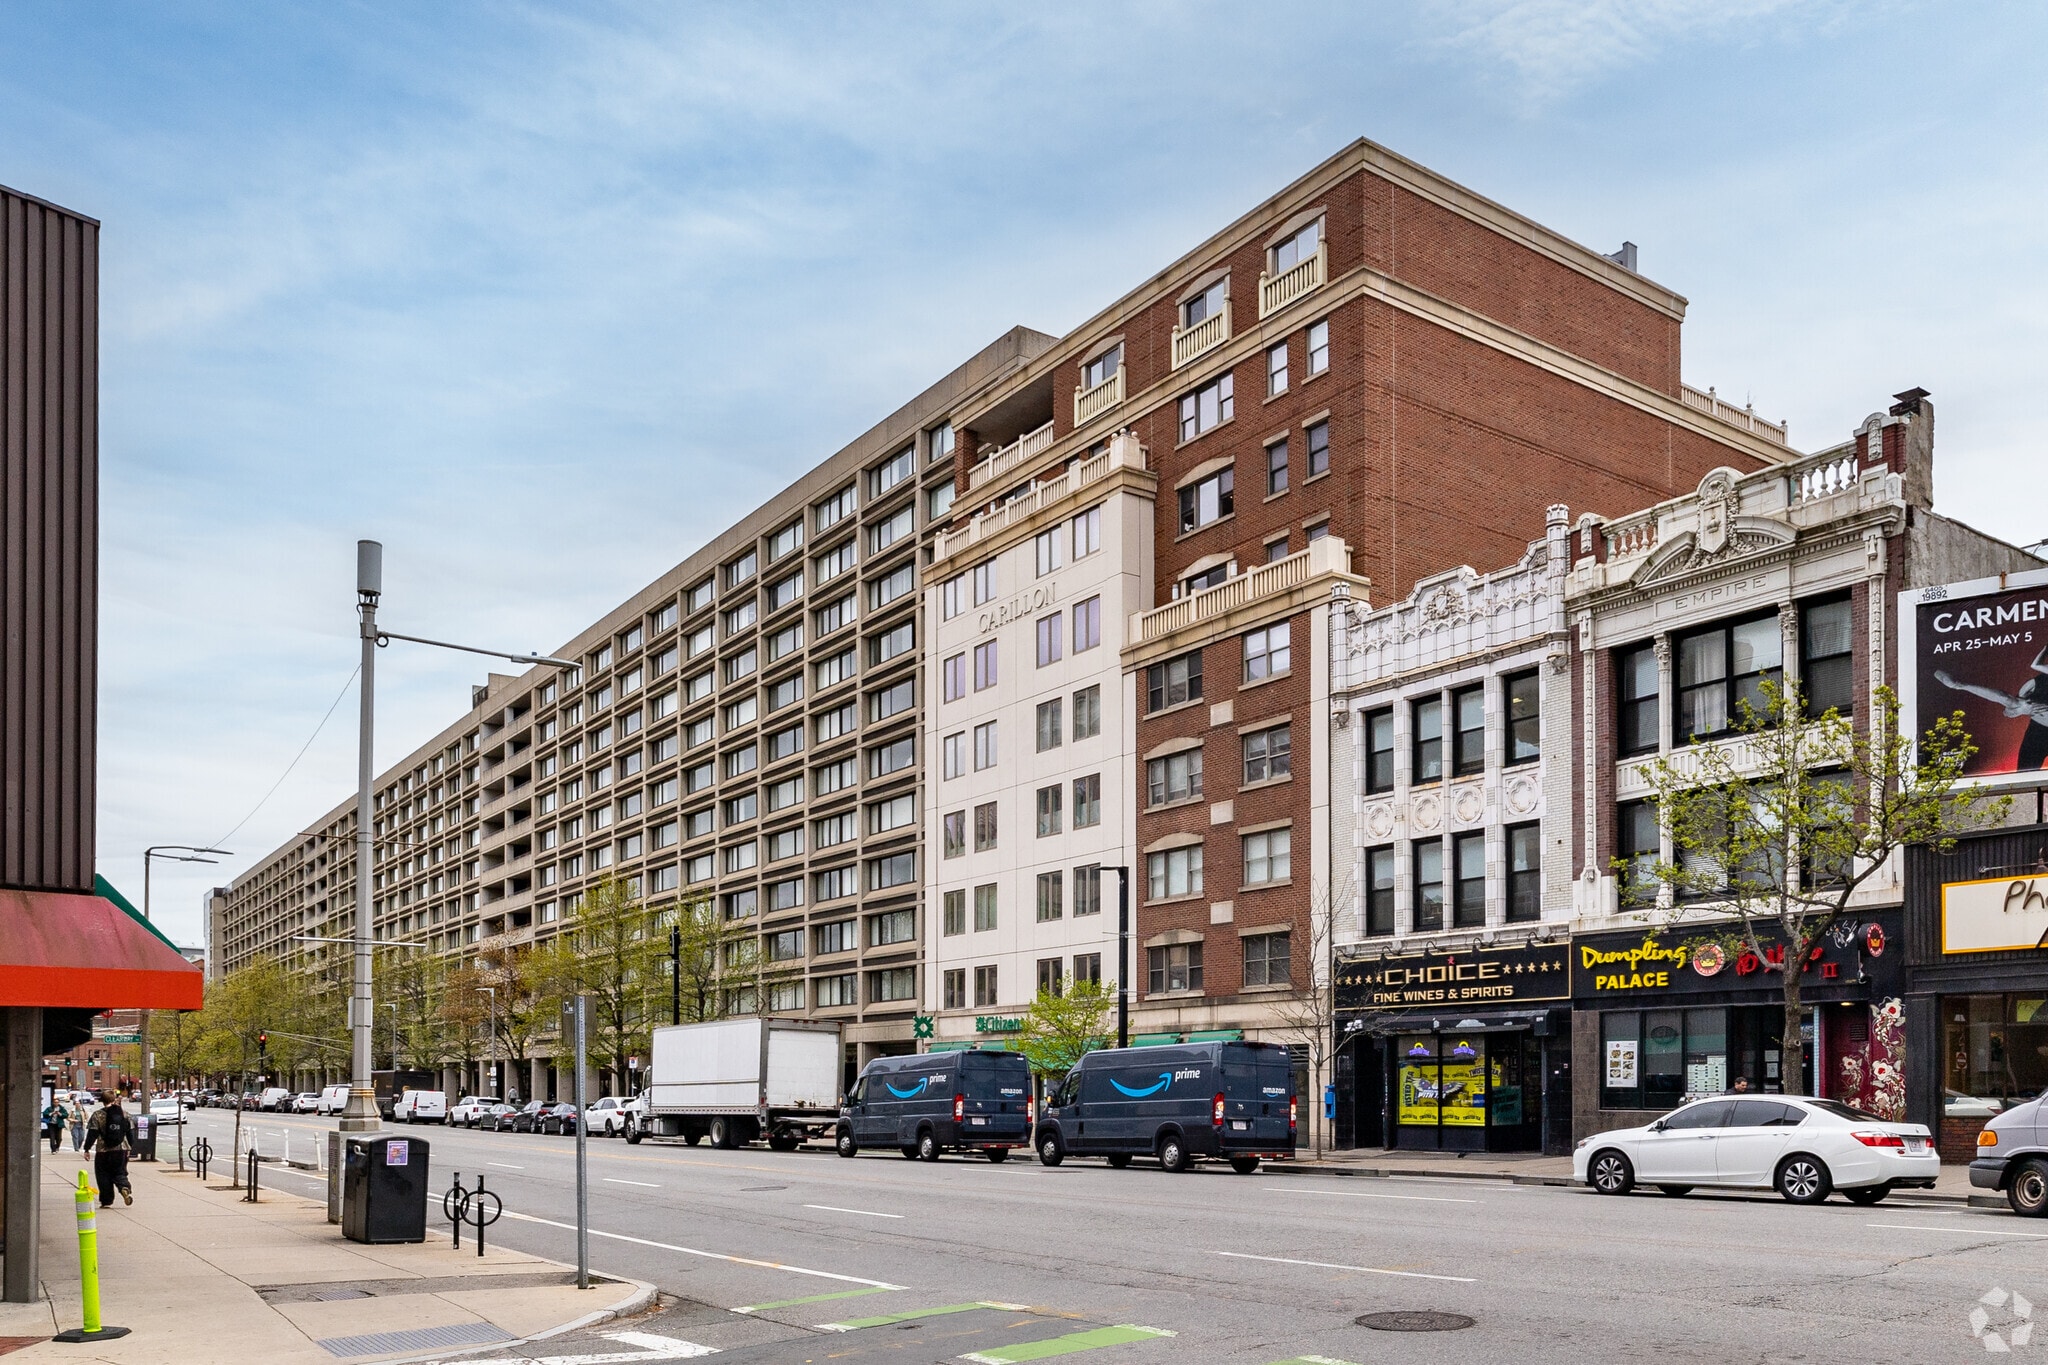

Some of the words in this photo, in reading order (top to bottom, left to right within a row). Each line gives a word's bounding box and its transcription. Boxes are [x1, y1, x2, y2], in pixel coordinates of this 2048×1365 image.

[1675, 575, 1766, 610] EMPIRE
[1922, 590, 1948, 601] 19892
[979, 582, 1056, 633] CARILLON
[1933, 641, 1962, 654] APR
[2024, 631, 2033, 642] 5
[2004, 879, 2048, 912] Ph
[1581, 940, 1688, 971] Dumpling
[1384, 961, 1501, 986] CHOICE
[1596, 971, 1669, 990] PALACE
[1373, 992, 1400, 1003] FINE
[1404, 990, 1445, 1001] WINES
[1447, 989, 1458, 999] &
[1461, 985, 1514, 999] SPIRITS
[929, 1073, 947, 1085] prime
[1175, 1068, 1201, 1082] prime
[1262, 1086, 1286, 1095] amazon
